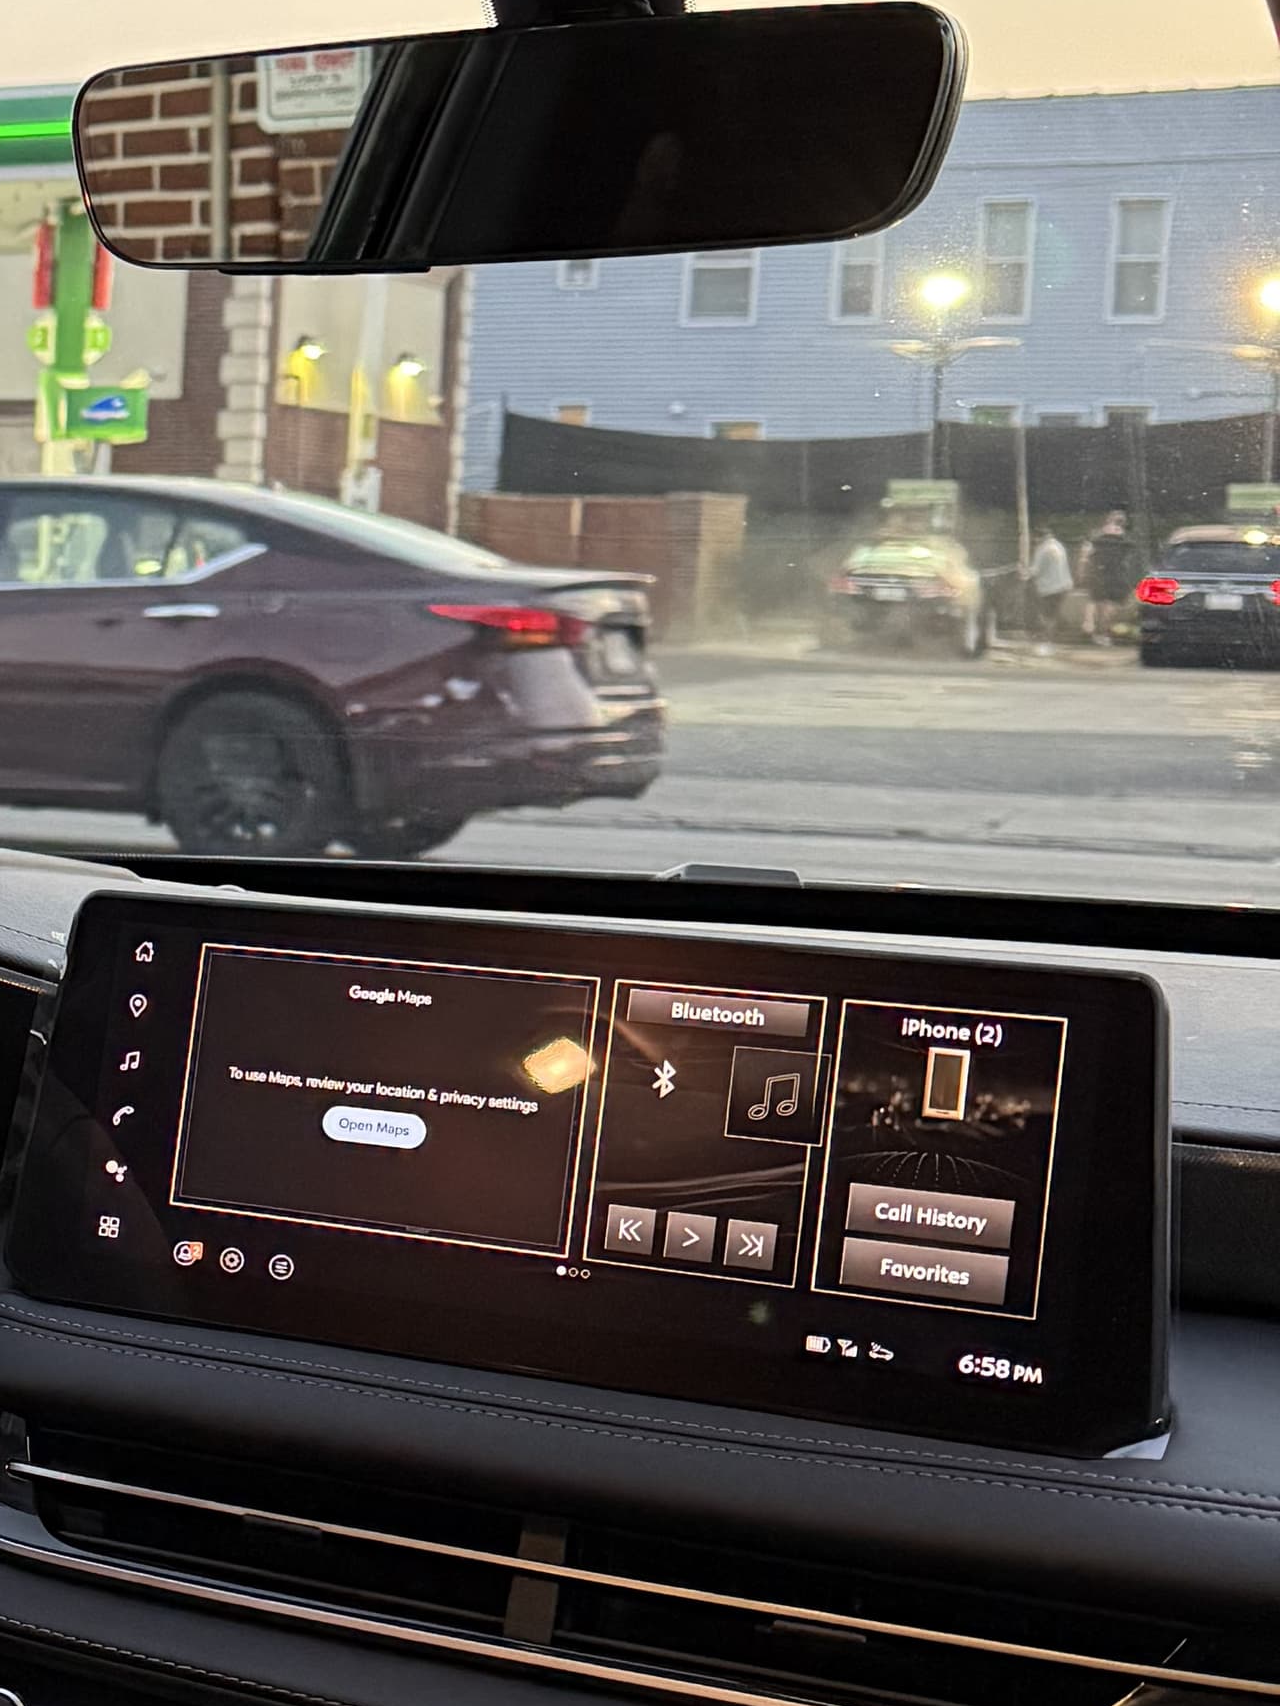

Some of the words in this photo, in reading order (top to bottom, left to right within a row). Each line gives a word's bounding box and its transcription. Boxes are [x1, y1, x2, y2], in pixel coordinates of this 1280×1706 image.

[349, 985, 396, 1006] Google
[397, 989, 433, 1007] Maps
[670, 1001, 766, 1027] Bluetooth
[901, 1016, 971, 1042] iPhone
[975, 1021, 1003, 1048] (2)
[229, 1066, 244, 1080] To
[245, 1070, 267, 1083] use
[268, 1070, 304, 1089] Maps,
[306, 1077, 345, 1092] review
[346, 1081, 375, 1096] your
[376, 1081, 426, 1101] location
[427, 1089, 438, 1102] &
[439, 1090, 487, 1109] privacy
[488, 1096, 539, 1115] settings
[338, 1117, 373, 1135] Open
[376, 1121, 410, 1139] Maps
[874, 1201, 912, 1224] Call
[916, 1207, 988, 1236] History
[880, 1258, 970, 1287] Favorites
[958, 1354, 1011, 1379] 6:58
[1013, 1364, 1043, 1384] PM
